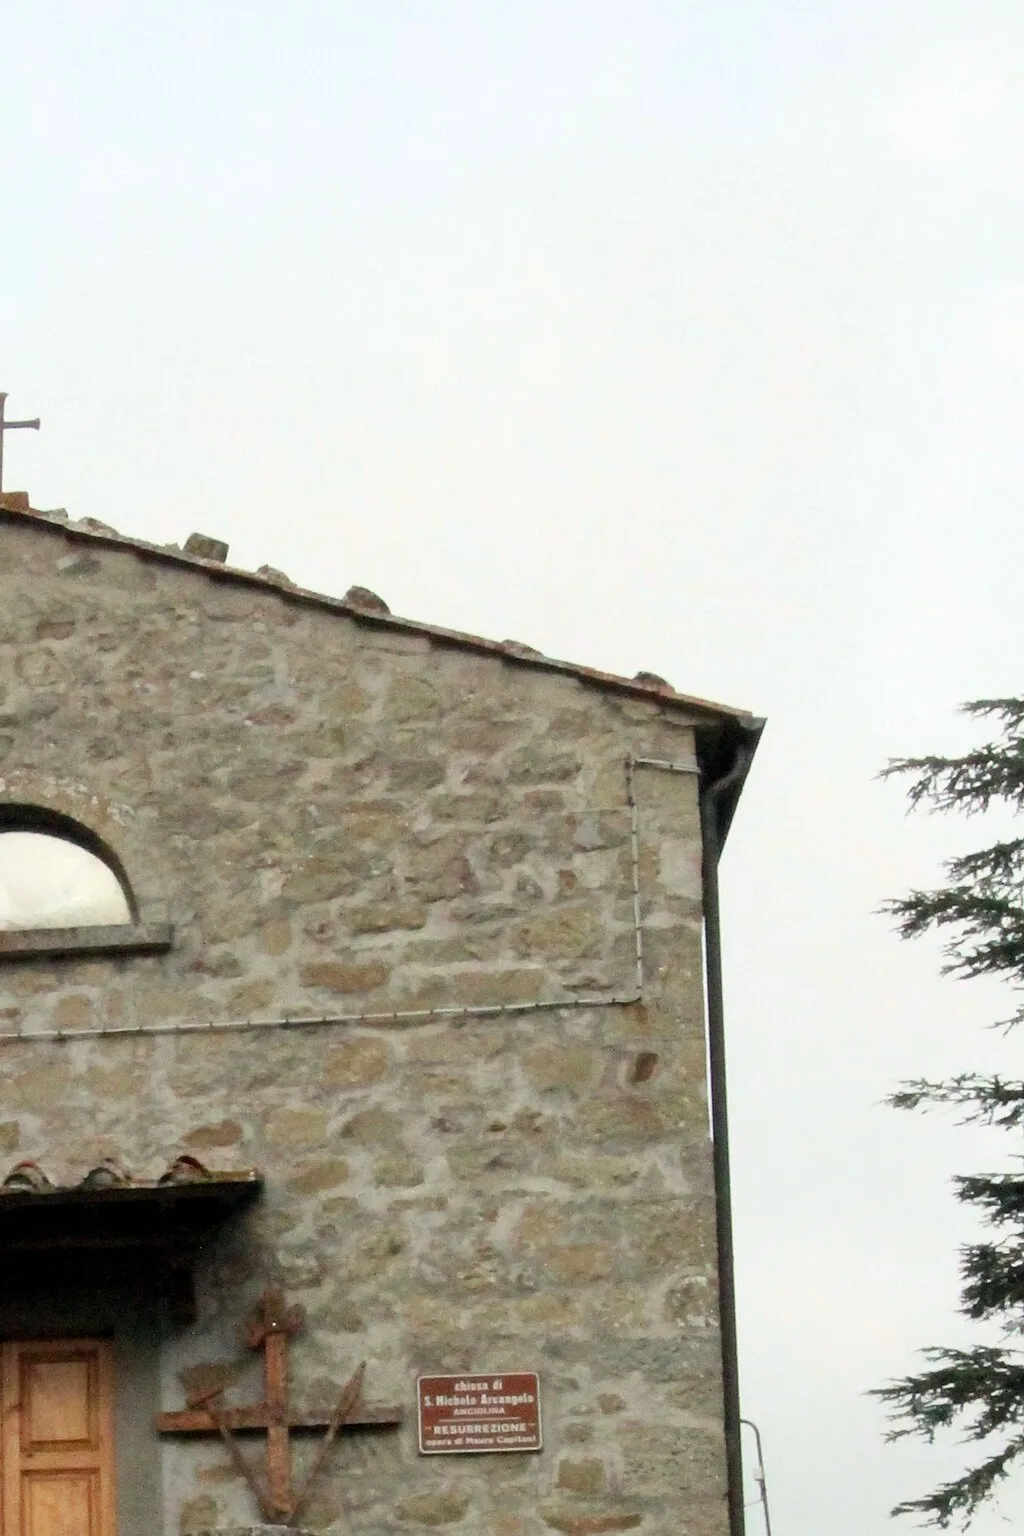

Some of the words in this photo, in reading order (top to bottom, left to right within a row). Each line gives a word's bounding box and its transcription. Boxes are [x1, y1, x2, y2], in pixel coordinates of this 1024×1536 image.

[492, 1379, 503, 1390] di
[424, 1395, 435, 1407] S.
[436, 1394, 477, 1406] Michele
[480, 1393, 534, 1406] Arcangelo
[454, 1437, 464, 1445] di
